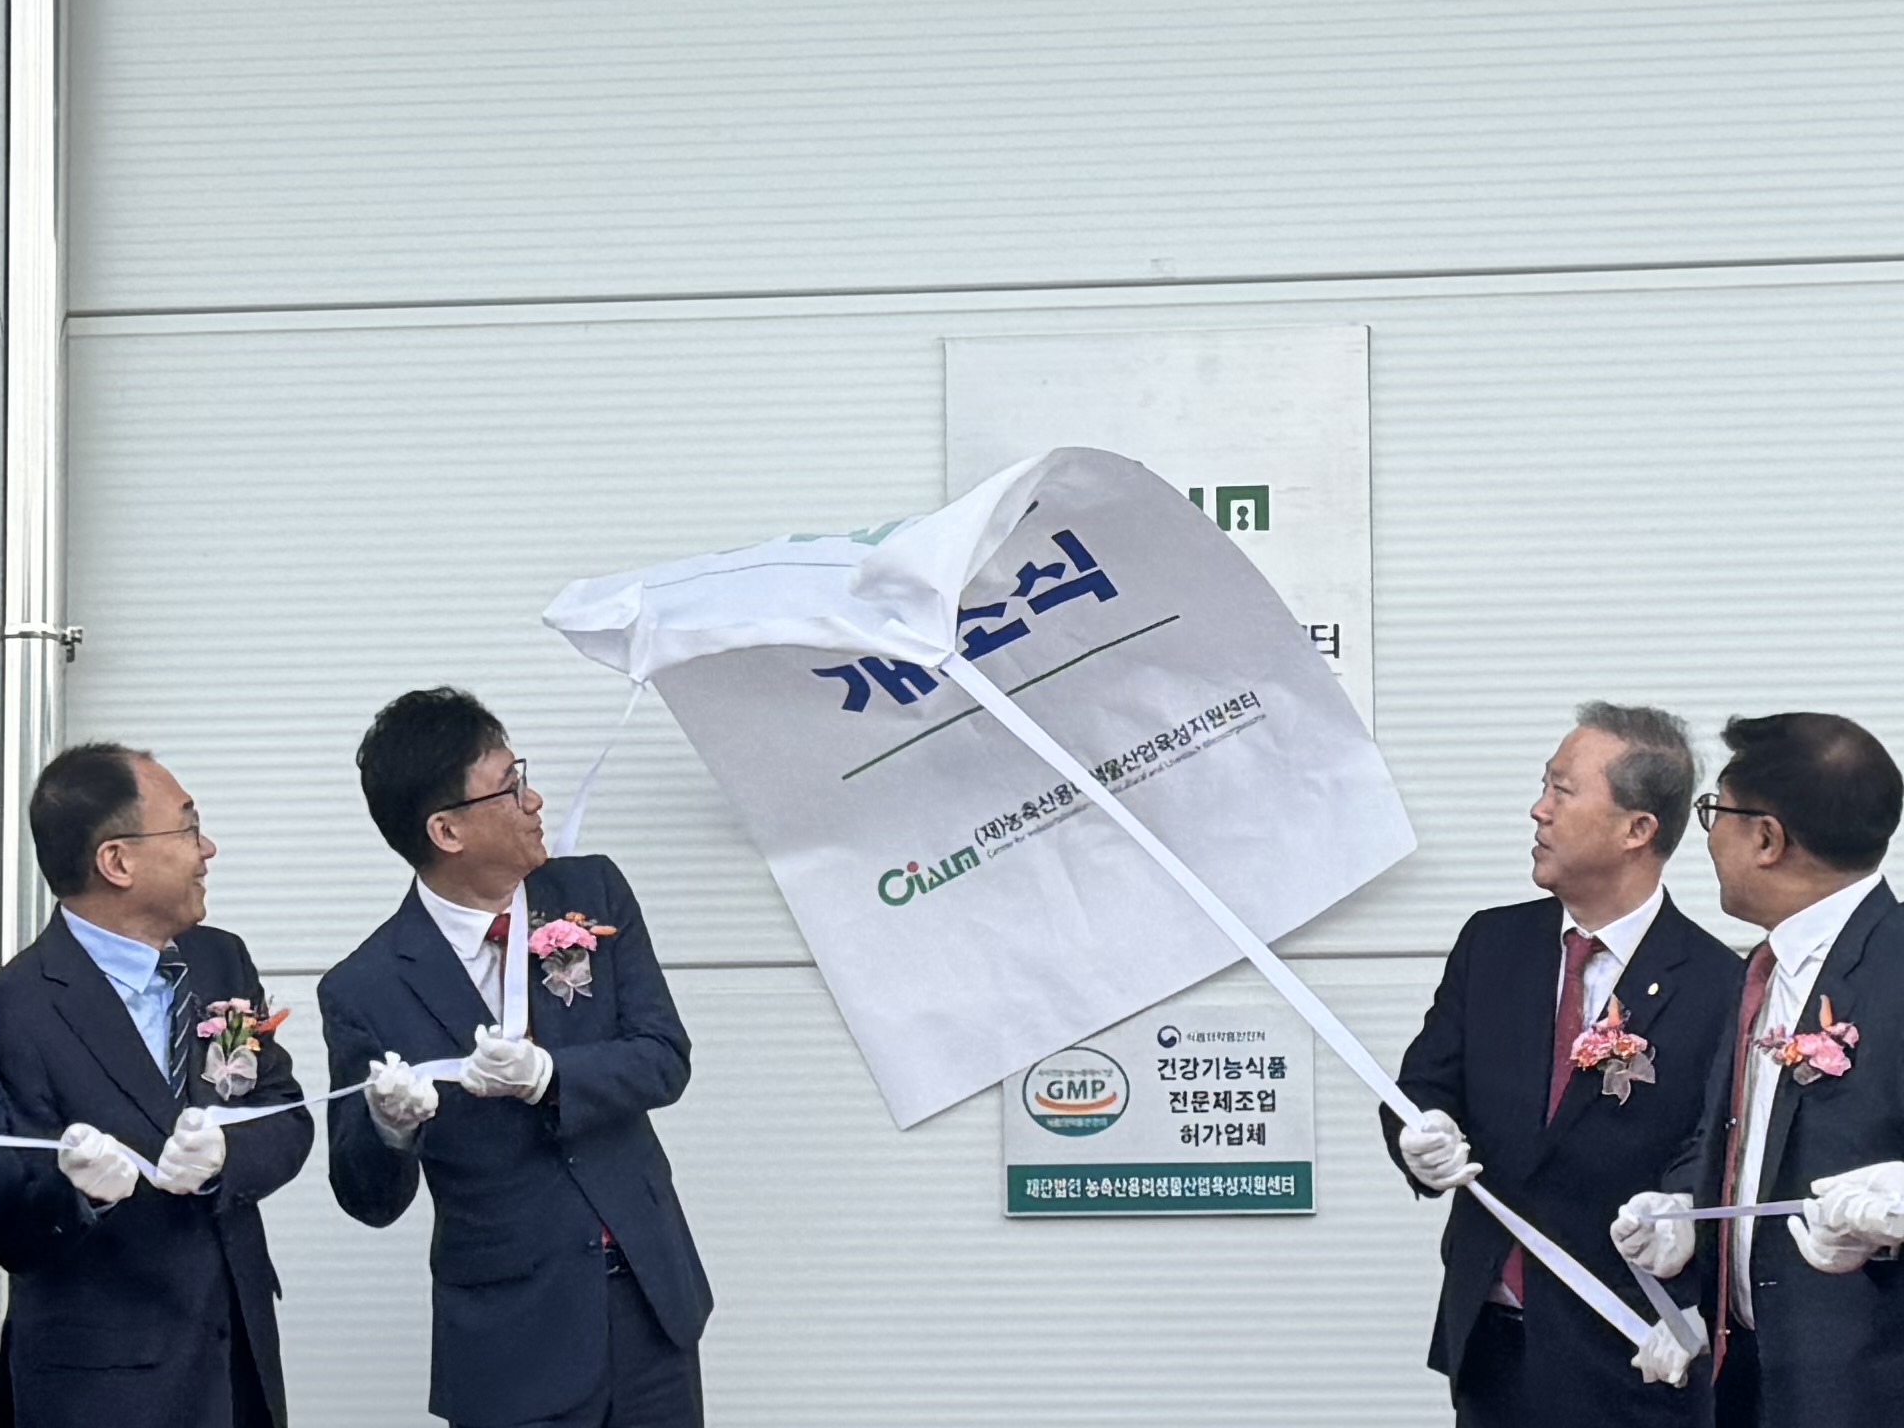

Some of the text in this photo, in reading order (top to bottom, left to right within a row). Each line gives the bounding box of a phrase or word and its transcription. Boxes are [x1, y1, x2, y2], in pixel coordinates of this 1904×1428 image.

[1157, 1056, 1286, 1080] 건강기능식품
[1046, 1079, 1106, 1100] GMP
[1169, 1089, 1276, 1113] 전문제조업
[1180, 1123, 1266, 1146] 허가업체
